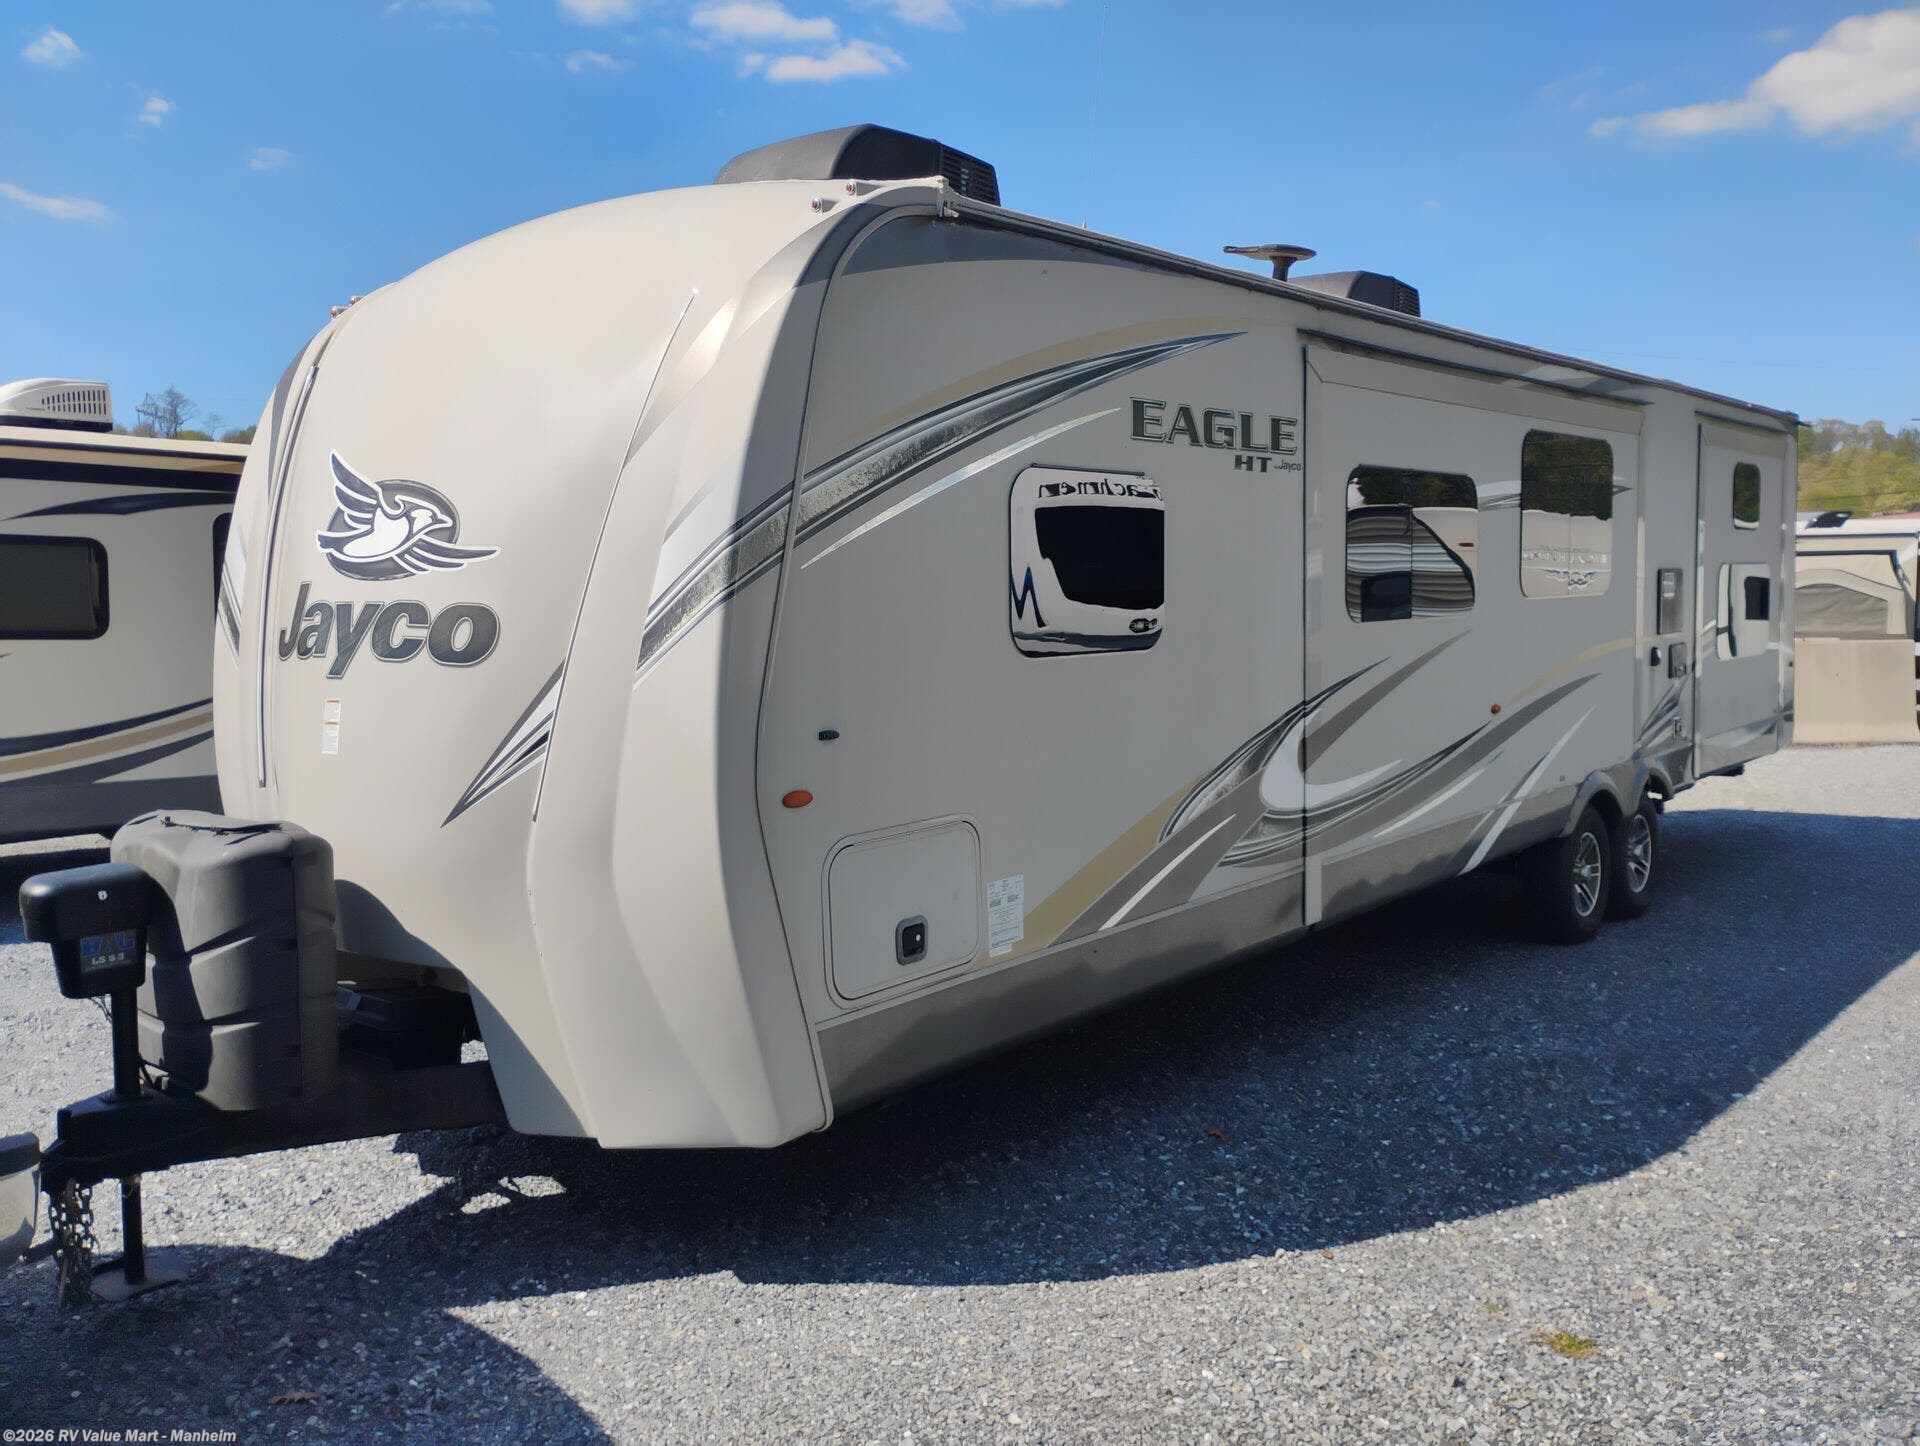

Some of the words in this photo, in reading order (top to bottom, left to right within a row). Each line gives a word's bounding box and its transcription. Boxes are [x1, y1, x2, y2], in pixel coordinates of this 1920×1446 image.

[1129, 396, 1298, 455] EAGLE
[1234, 454, 1273, 473] HT
[1278, 459, 1302, 473] Jayco
[279, 582, 501, 680] Jayco
